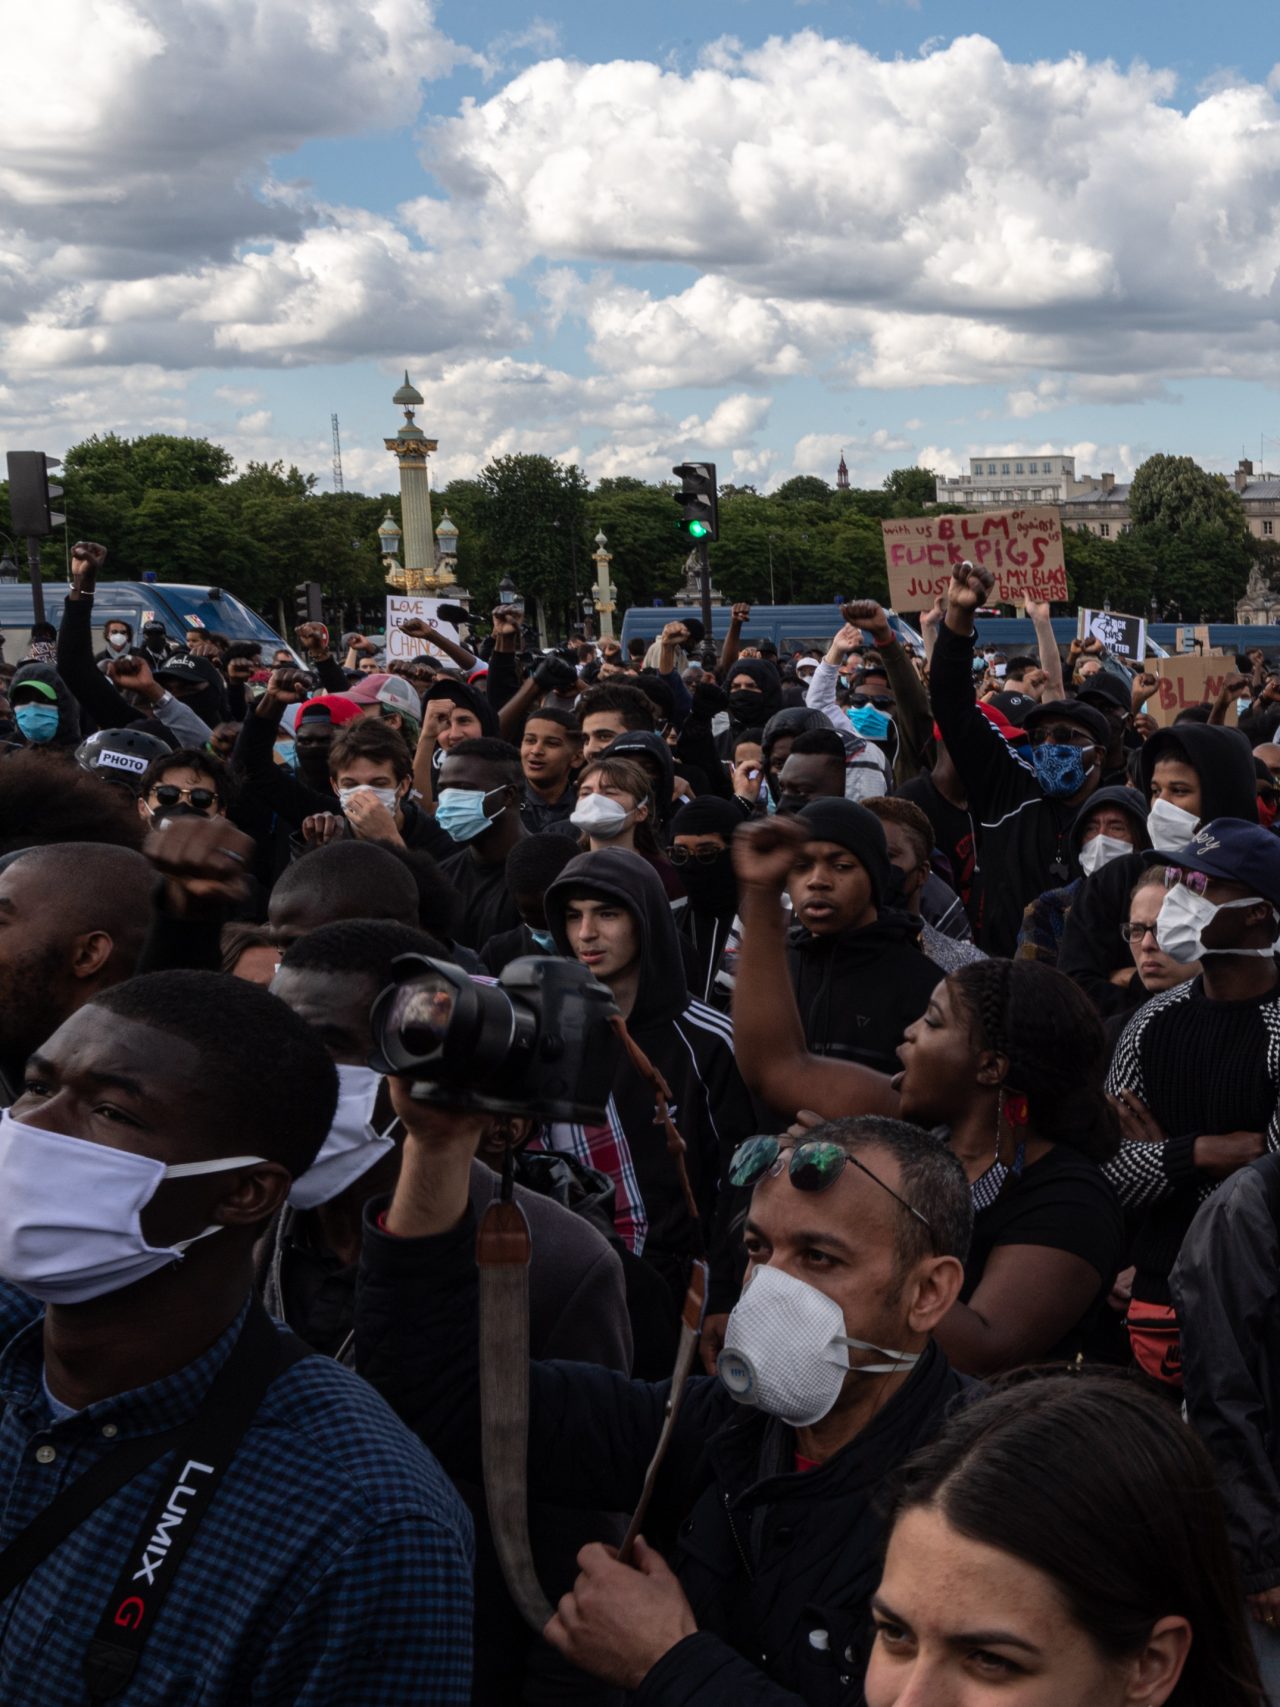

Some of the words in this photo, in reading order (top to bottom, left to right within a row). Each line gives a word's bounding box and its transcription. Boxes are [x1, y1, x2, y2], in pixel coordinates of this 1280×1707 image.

[884, 524, 911, 536] with
[915, 525, 932, 538] us
[938, 515, 1010, 541] BLM
[1017, 518, 1056, 538] against
[1048, 531, 1061, 542] us
[891, 542, 966, 567] FUCK
[1007, 568, 1027, 585] MY
[1000, 585, 1066, 603] BROTHERS
[390, 600, 424, 614] LOVE
[427, 618, 438, 628] TO
[1160, 675, 1225, 710] BLM
[102, 753, 144, 771] PHOTO
[132, 1459, 215, 1586] LUMIX
[114, 1596, 145, 1631] G
